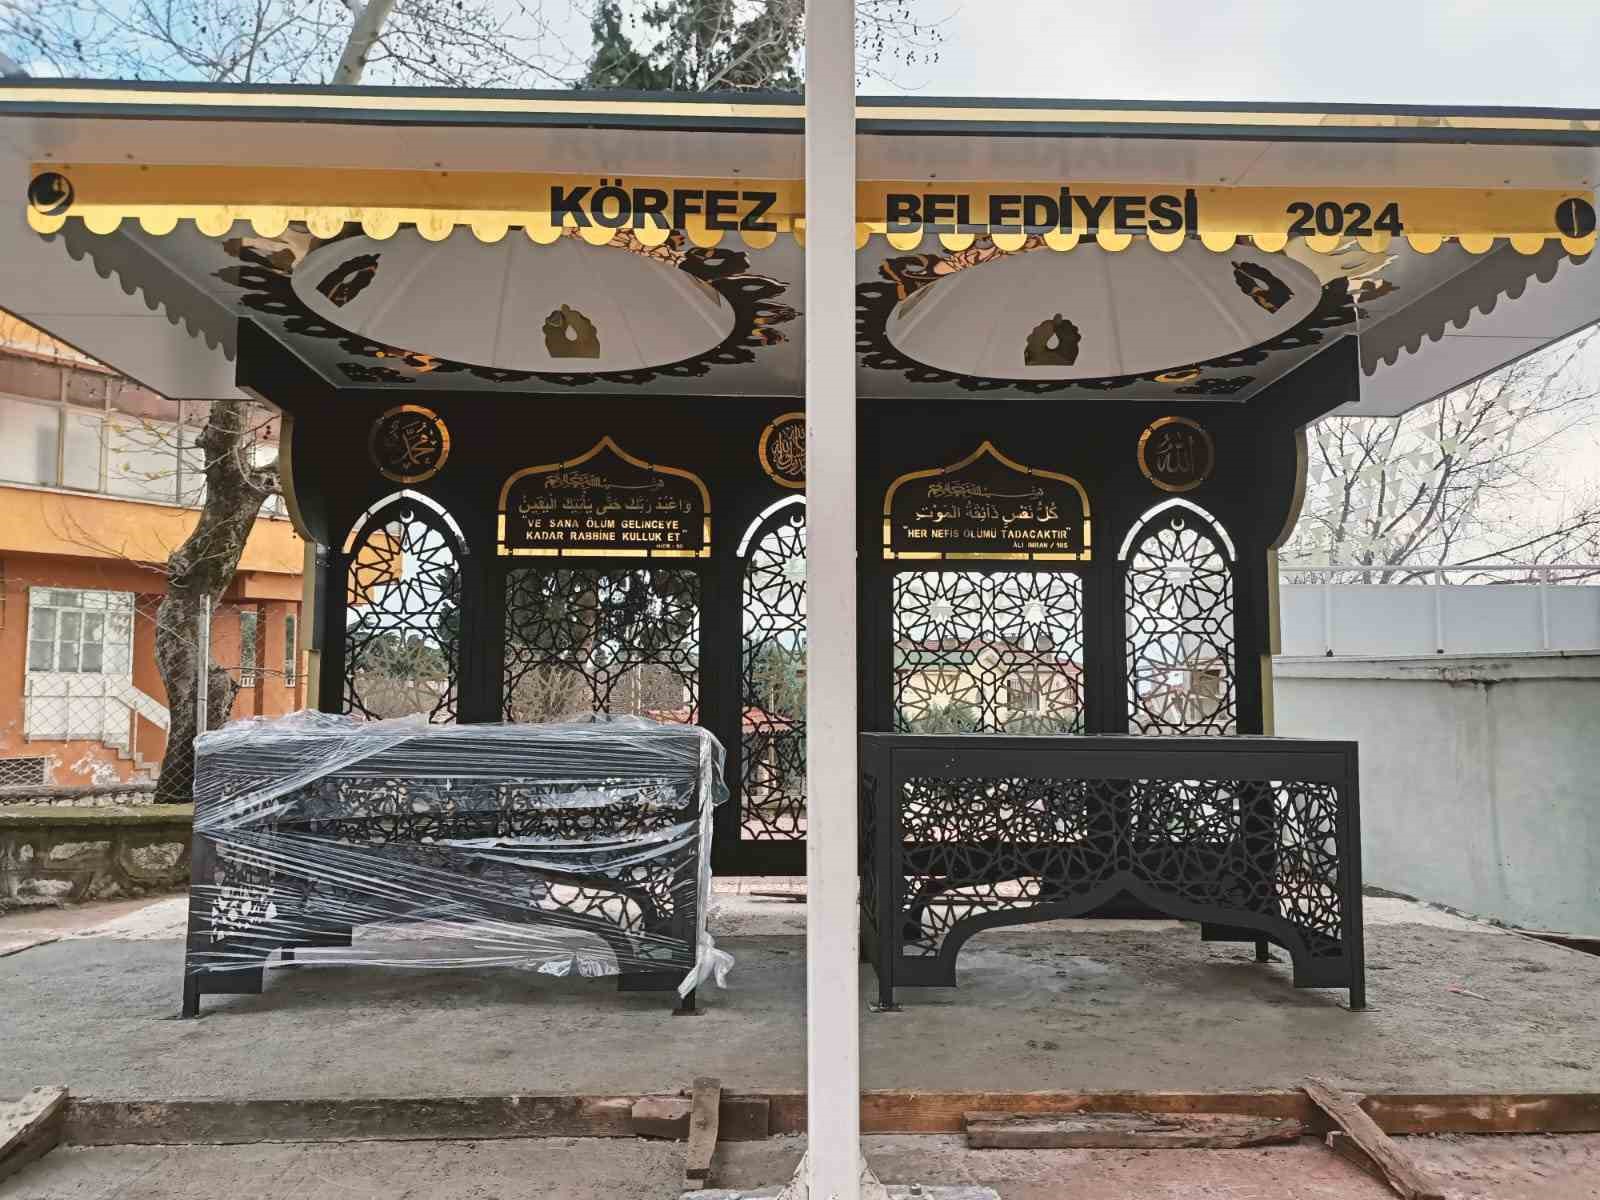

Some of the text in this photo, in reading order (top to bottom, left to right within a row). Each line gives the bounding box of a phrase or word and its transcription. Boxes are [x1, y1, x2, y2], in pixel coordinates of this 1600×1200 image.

[551, 178, 1404, 238] KÖRFEZ BELEDİYESİ 2024
[549, 519, 580, 528] SANA
[526, 531, 564, 541] KADAR
[622, 531, 662, 541] KULLUK
